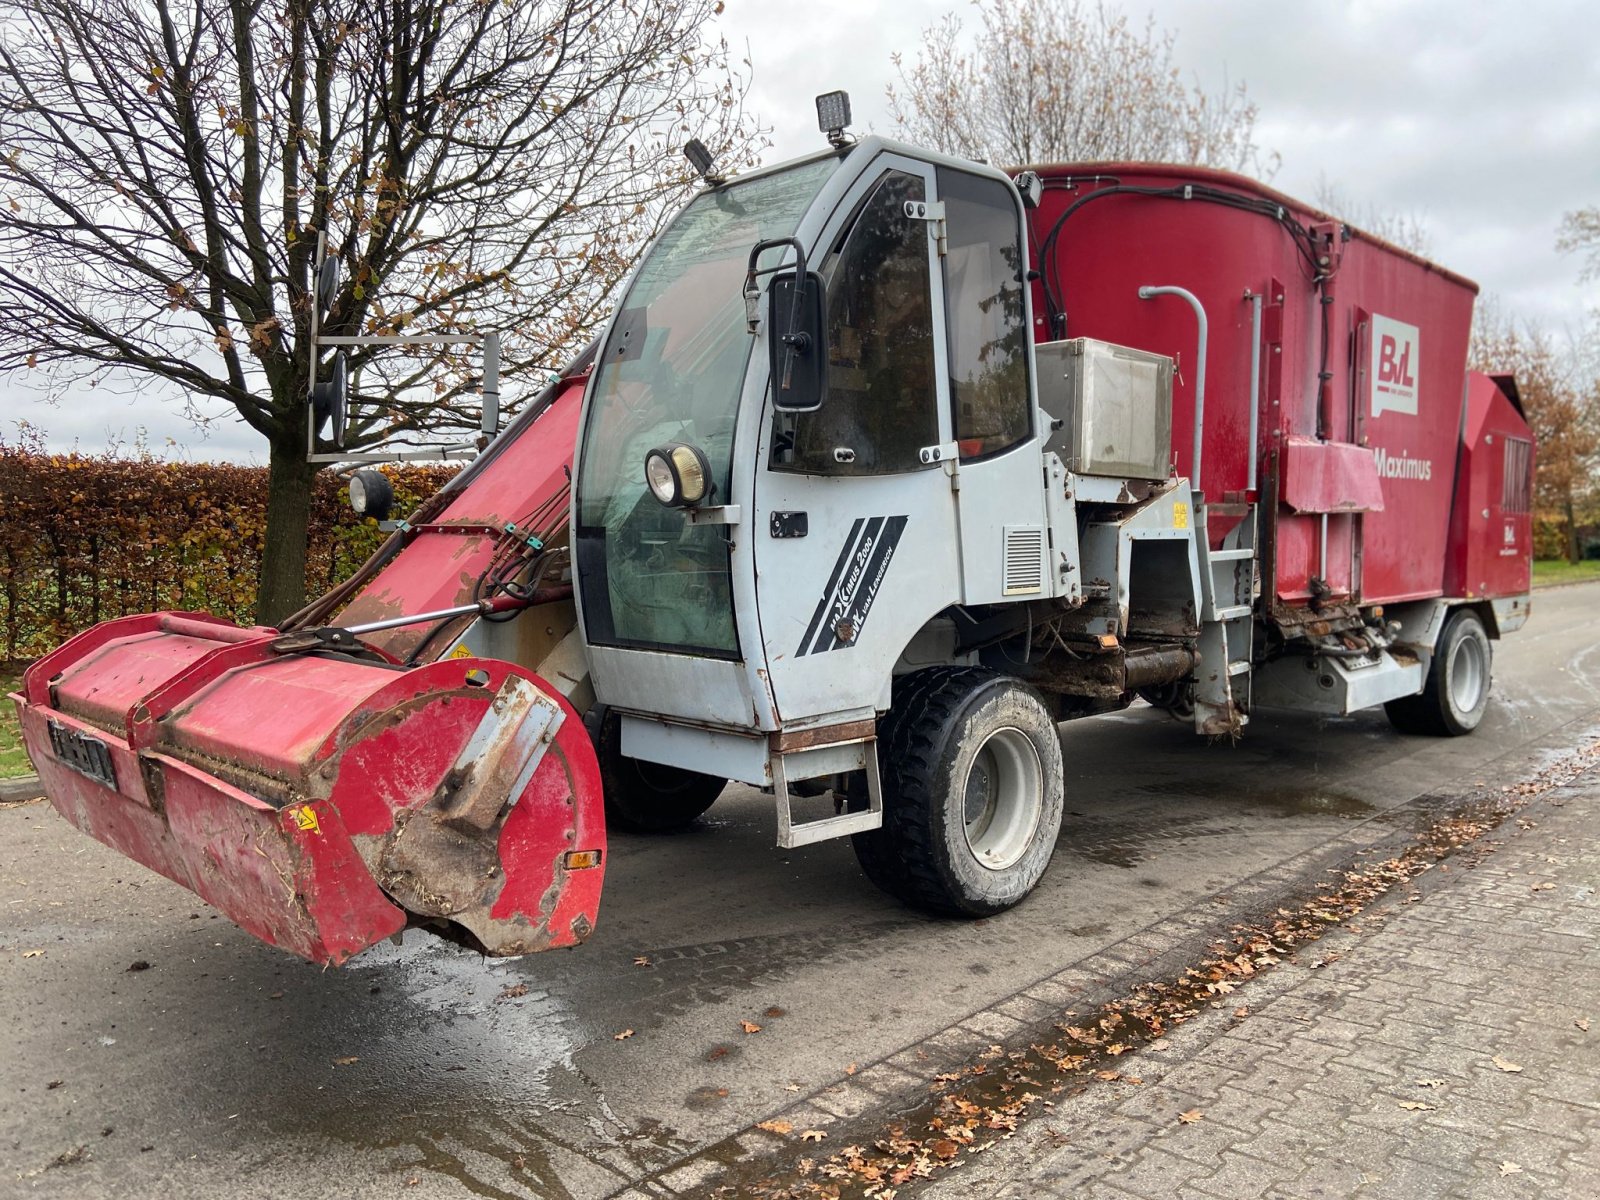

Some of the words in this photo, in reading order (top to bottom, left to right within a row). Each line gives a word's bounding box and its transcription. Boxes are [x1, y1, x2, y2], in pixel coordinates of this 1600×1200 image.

[1374, 447, 1432, 481] Maximus
[856, 537, 873, 567] 2000
[862, 596, 873, 614] VAN
[868, 546, 893, 595] LENGERICH
